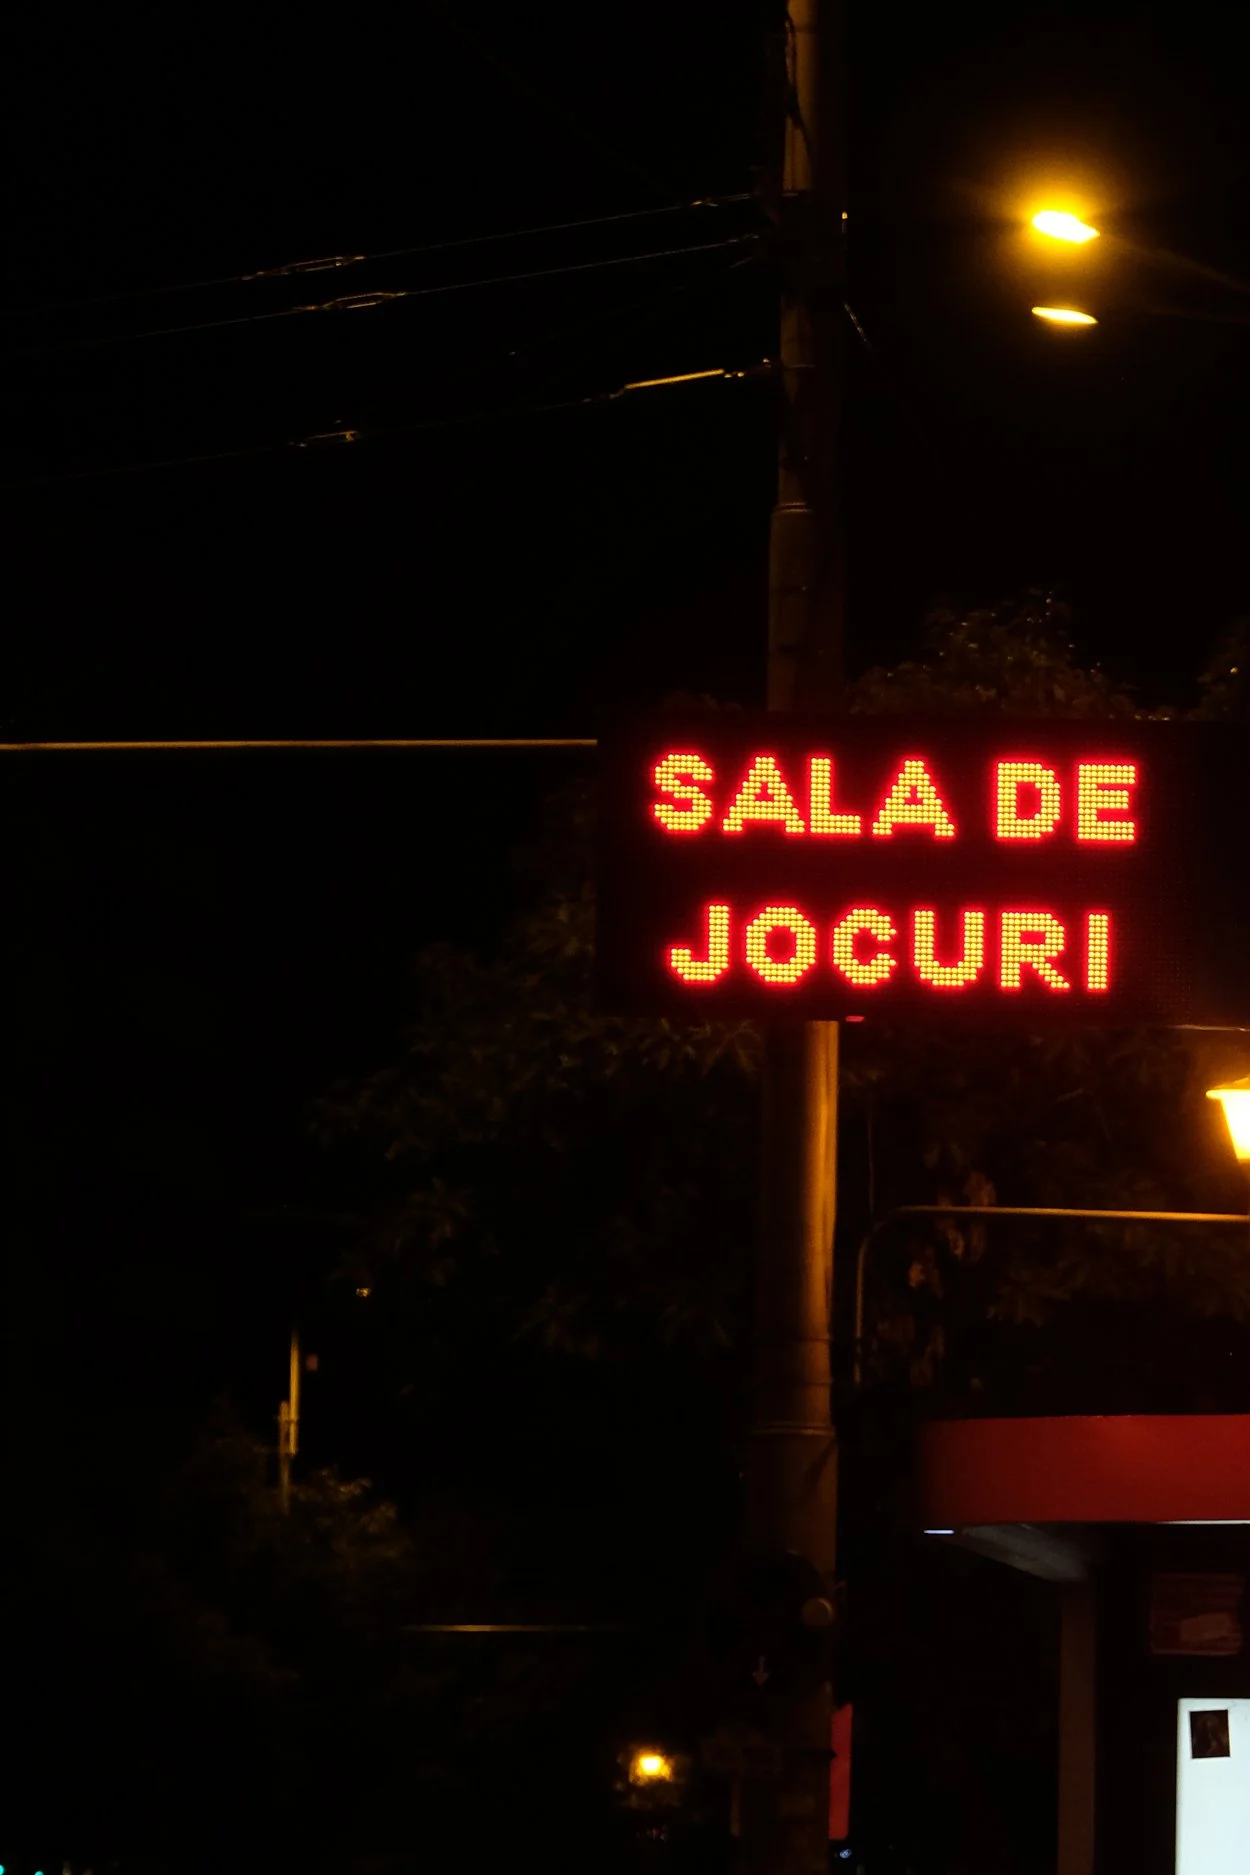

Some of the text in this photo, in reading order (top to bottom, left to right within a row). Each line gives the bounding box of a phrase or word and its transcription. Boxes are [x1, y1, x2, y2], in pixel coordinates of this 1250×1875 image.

[653, 753, 1136, 841] SALA DE
[669, 904, 1109, 989] JOCURI
